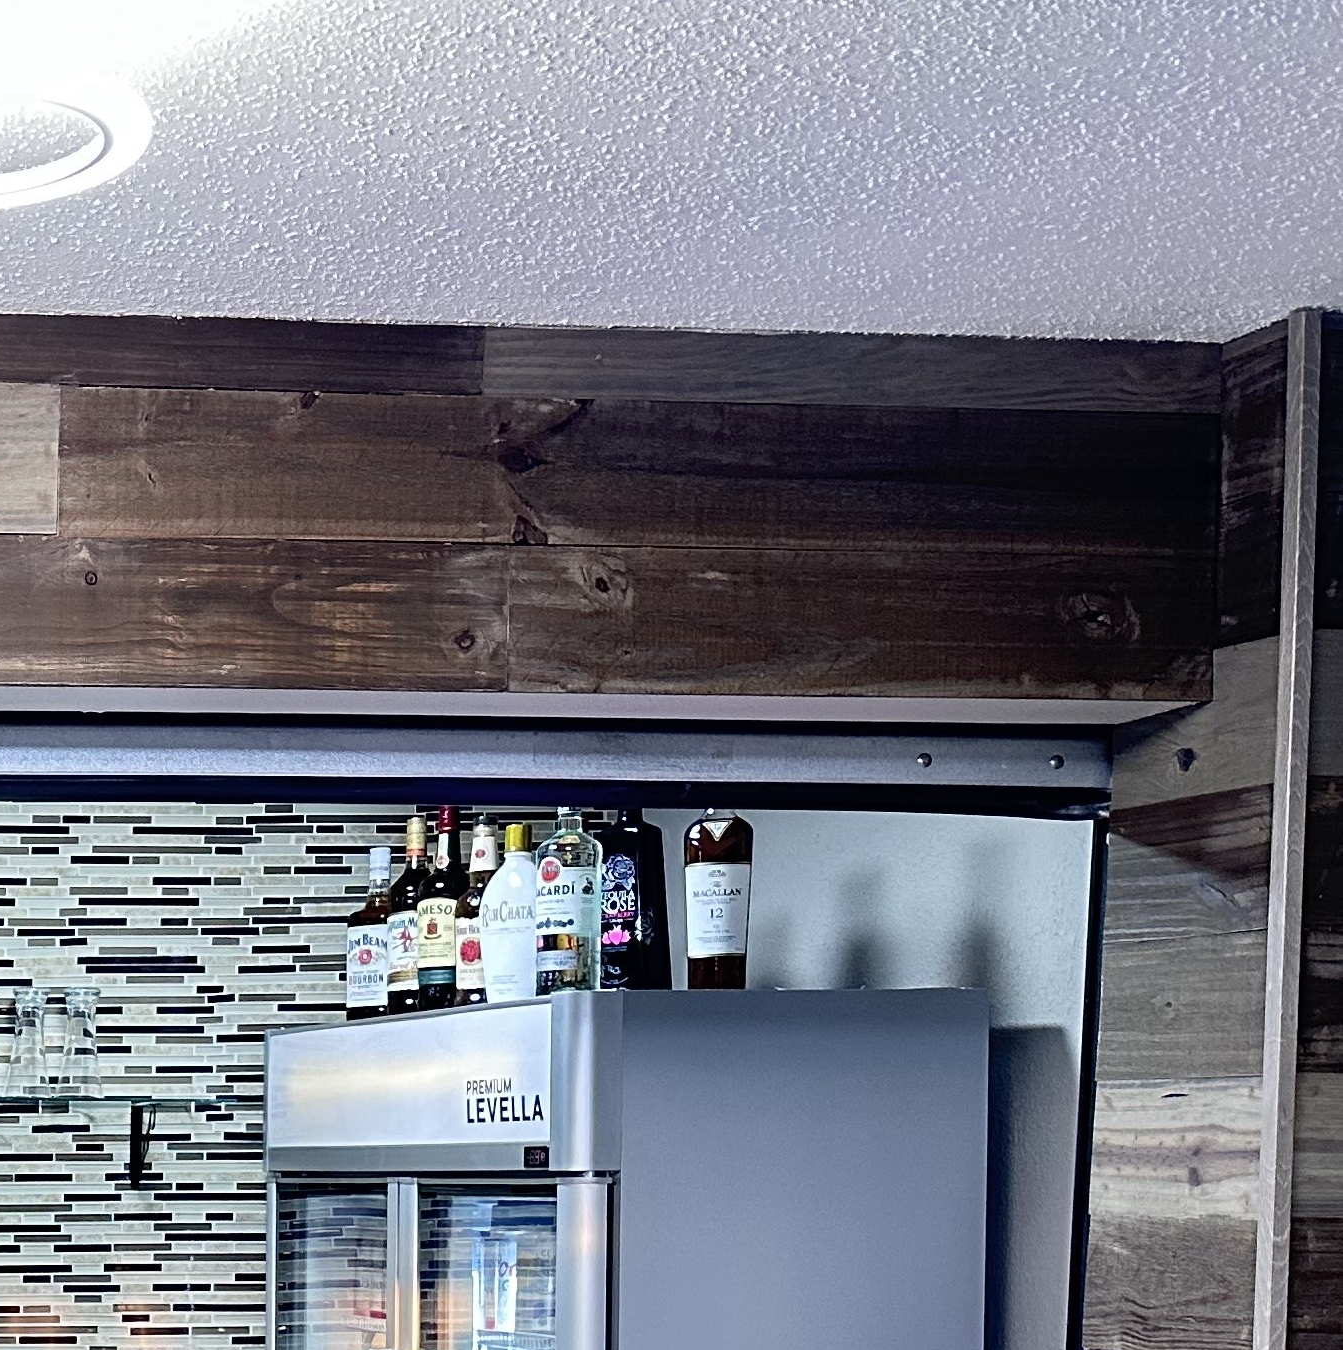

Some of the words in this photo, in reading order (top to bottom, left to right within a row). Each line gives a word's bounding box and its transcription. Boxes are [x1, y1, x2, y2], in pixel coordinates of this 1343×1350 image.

[693, 888, 741, 898] MACALLAN
[709, 908, 724, 919] 12
[466, 1077, 512, 1095] PREMIUM
[466, 1094, 544, 1123] LEVELLA
